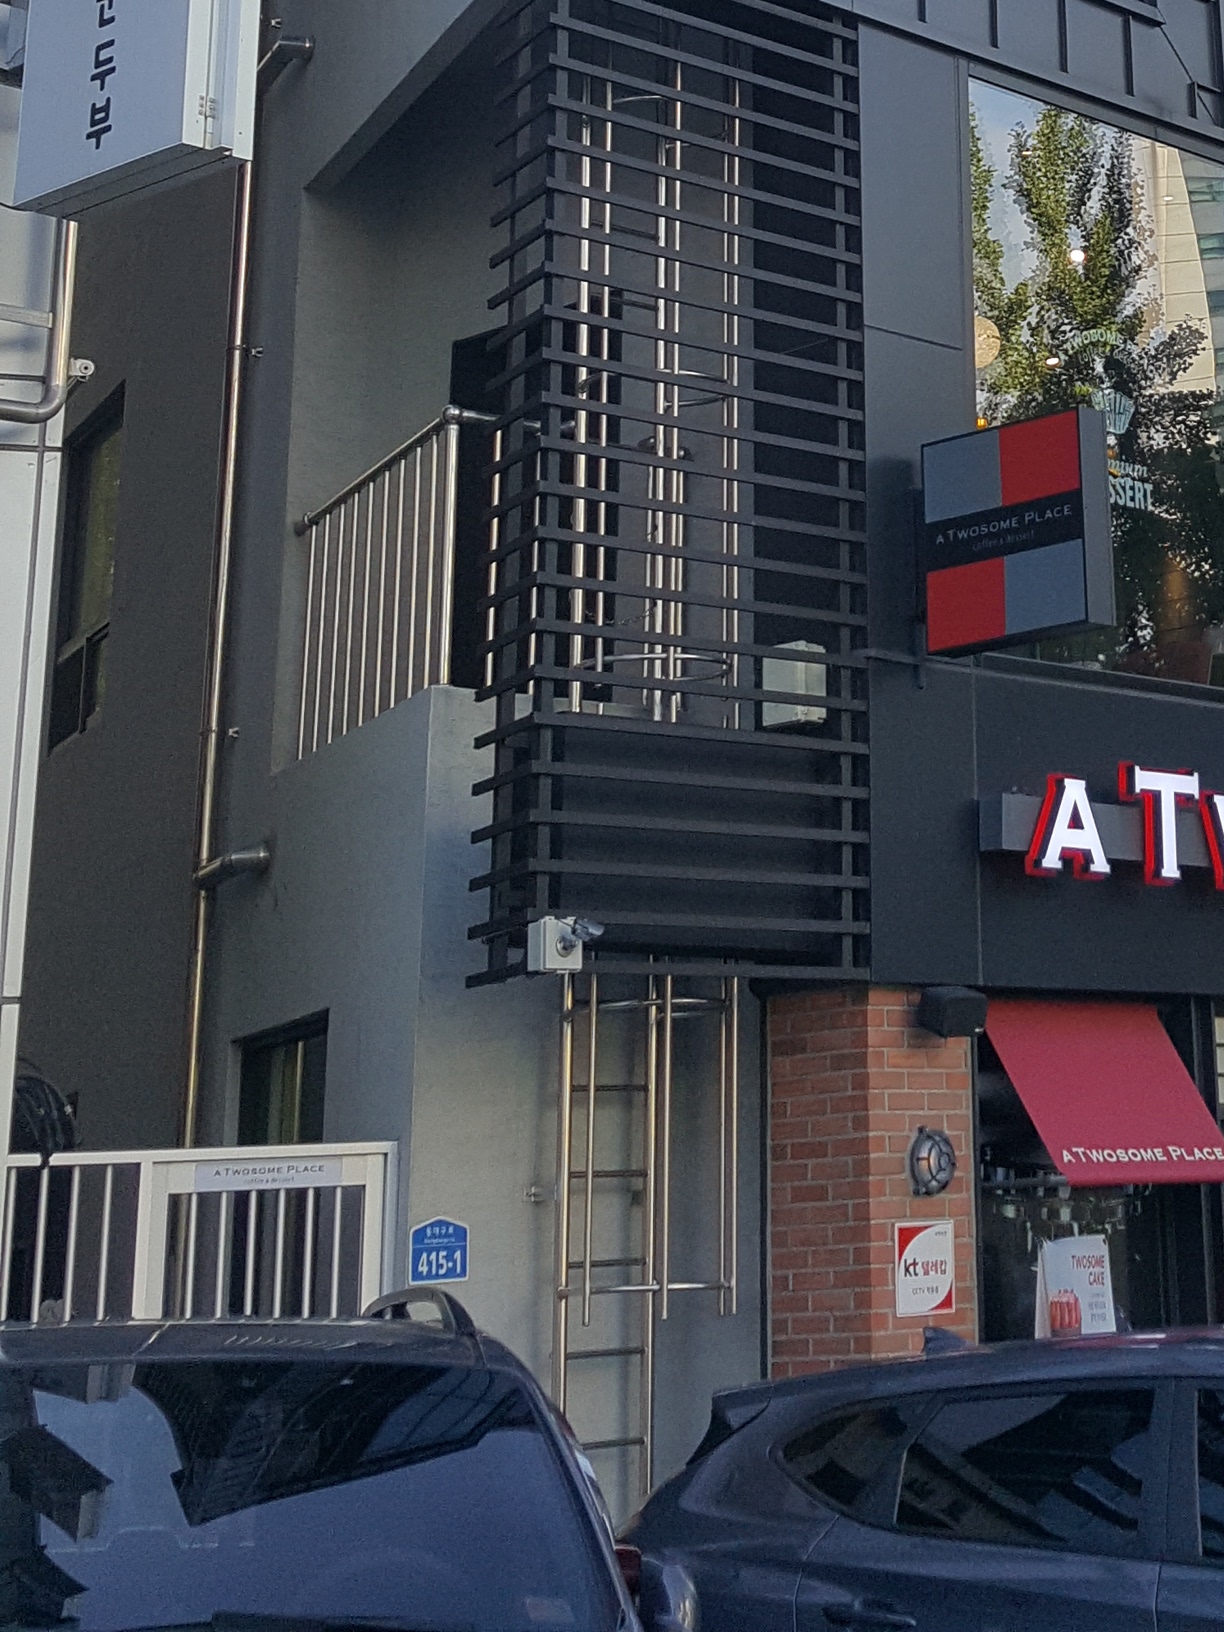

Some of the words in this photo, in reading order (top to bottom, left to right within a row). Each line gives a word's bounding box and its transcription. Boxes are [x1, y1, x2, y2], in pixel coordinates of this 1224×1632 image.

[1108, 476, 1153, 511] SSERT
[936, 534, 945, 546] A
[946, 516, 1020, 542] TWOSOME
[1024, 505, 1073, 525] PLACE
[1028, 774, 1111, 878] A
[1062, 1150, 1075, 1164] A
[1071, 1147, 1167, 1163] TWOSOME
[223, 1167, 284, 1177] TWOSOME
[287, 1165, 325, 1174] PLACE
[418, 1250, 461, 1276] 415-1
[904, 1257, 919, 1277] kt
[1071, 1254, 1105, 1269] TWOSOME
[1088, 1271, 1105, 1287] CAKE
